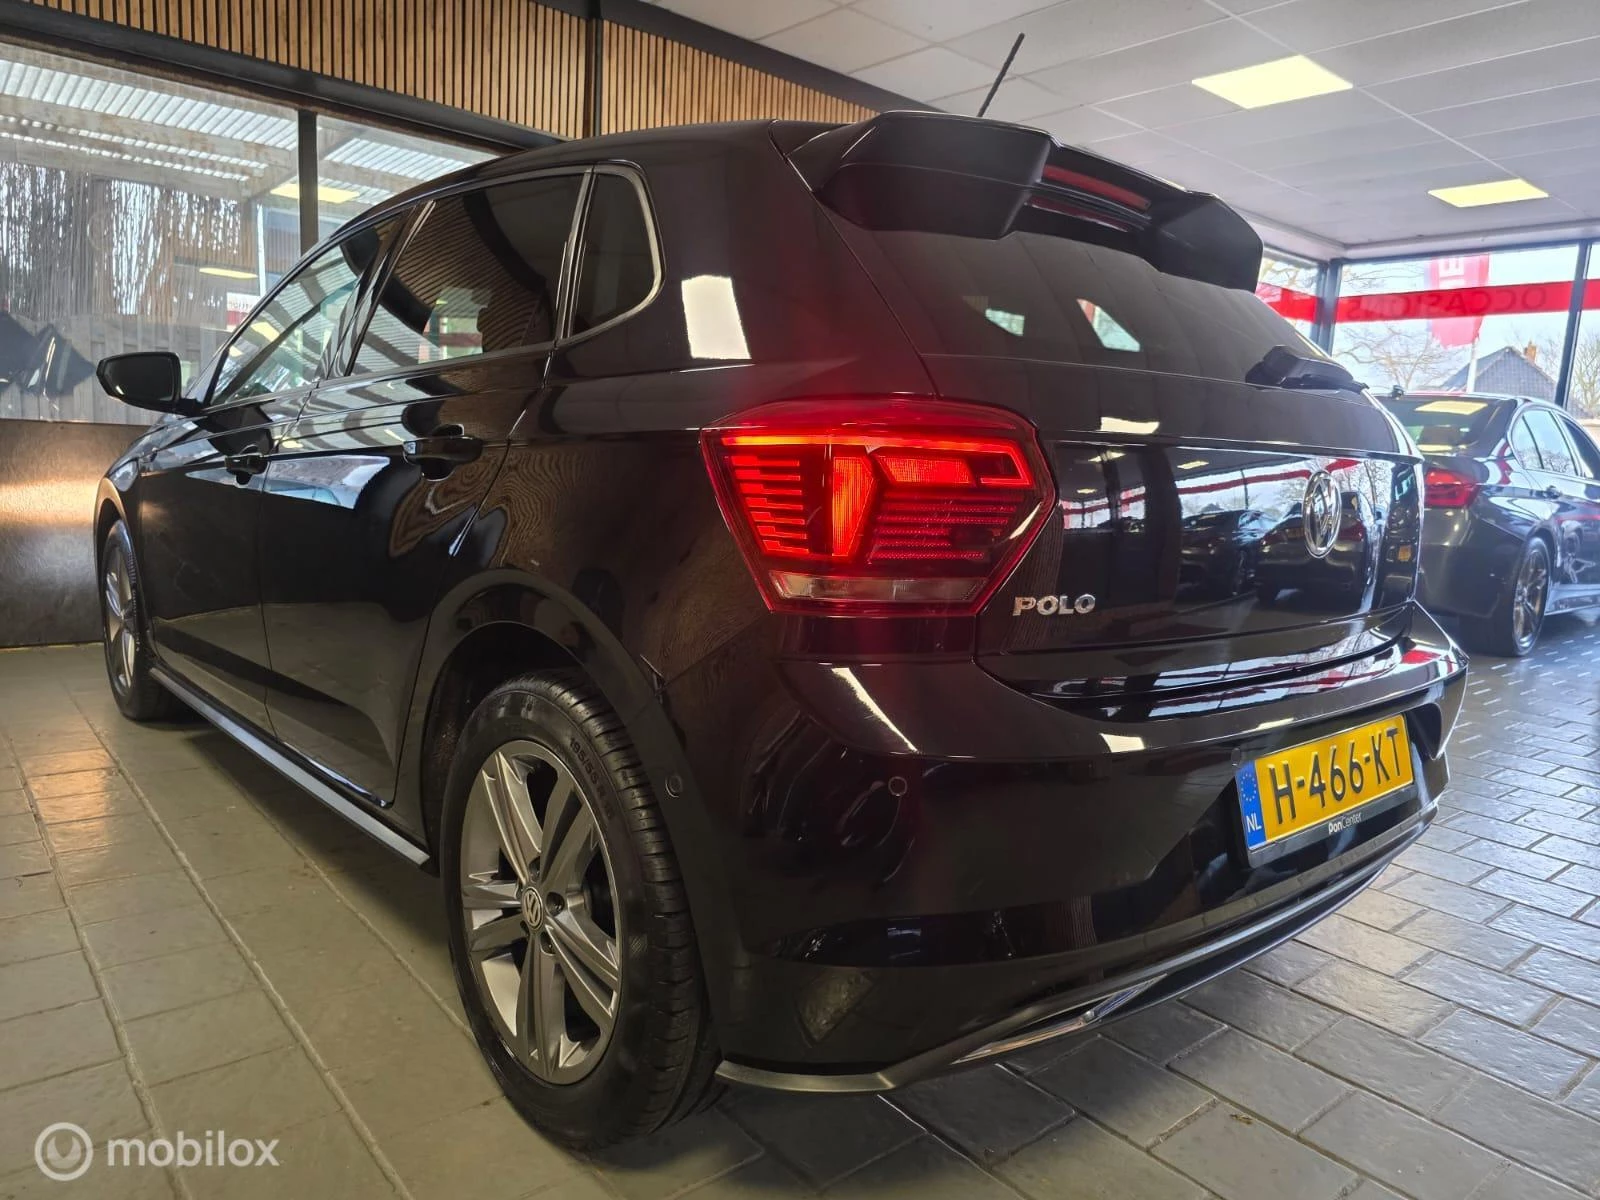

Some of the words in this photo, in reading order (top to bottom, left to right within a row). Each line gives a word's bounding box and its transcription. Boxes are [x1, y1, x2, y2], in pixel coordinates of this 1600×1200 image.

[1012, 593, 1096, 616] POLO
[1266, 726, 1401, 825] H-466-KT
[1246, 813, 1262, 833] NL
